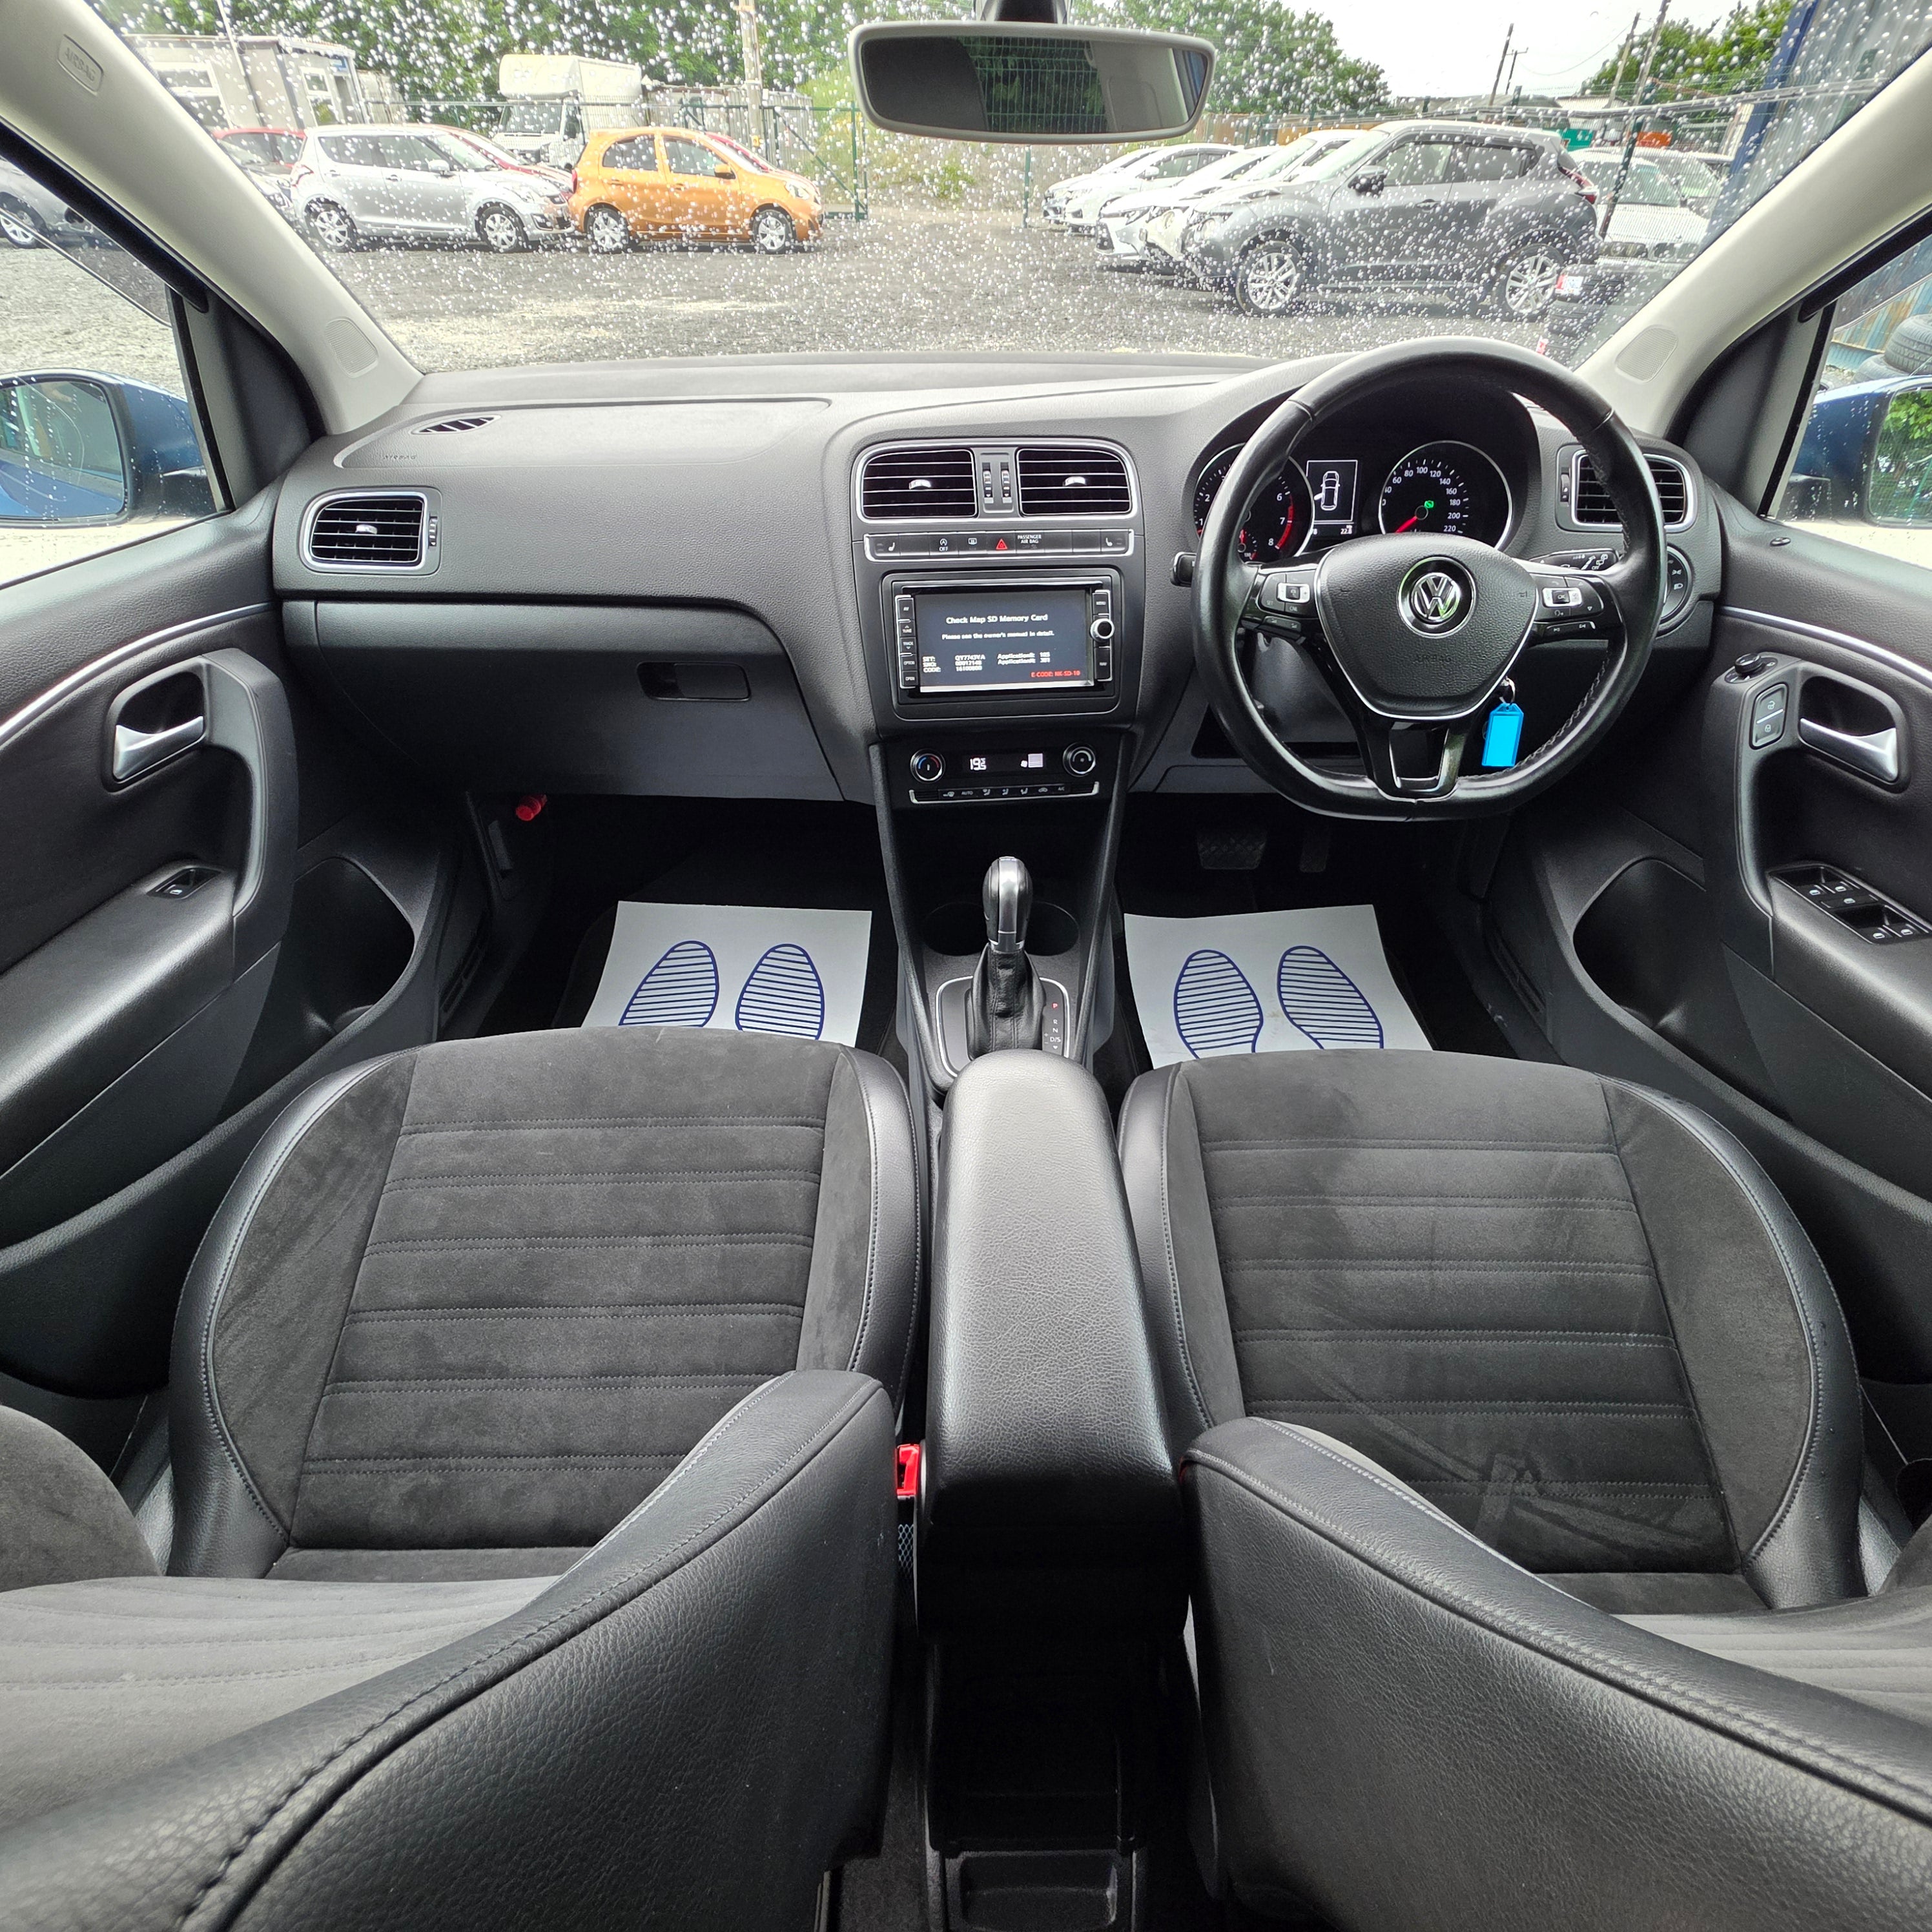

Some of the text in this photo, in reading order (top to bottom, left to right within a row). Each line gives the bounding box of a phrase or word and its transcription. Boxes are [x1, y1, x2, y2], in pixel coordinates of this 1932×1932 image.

[1430, 469, 1441, 478] 120
[1392, 476, 1402, 484] 60
[1204, 493, 1210, 502] 2
[1276, 493, 1282, 501] 6
[1279, 517, 1285, 525] 7
[1268, 538, 1274, 546] 8
[969, 616, 986, 624] Map
